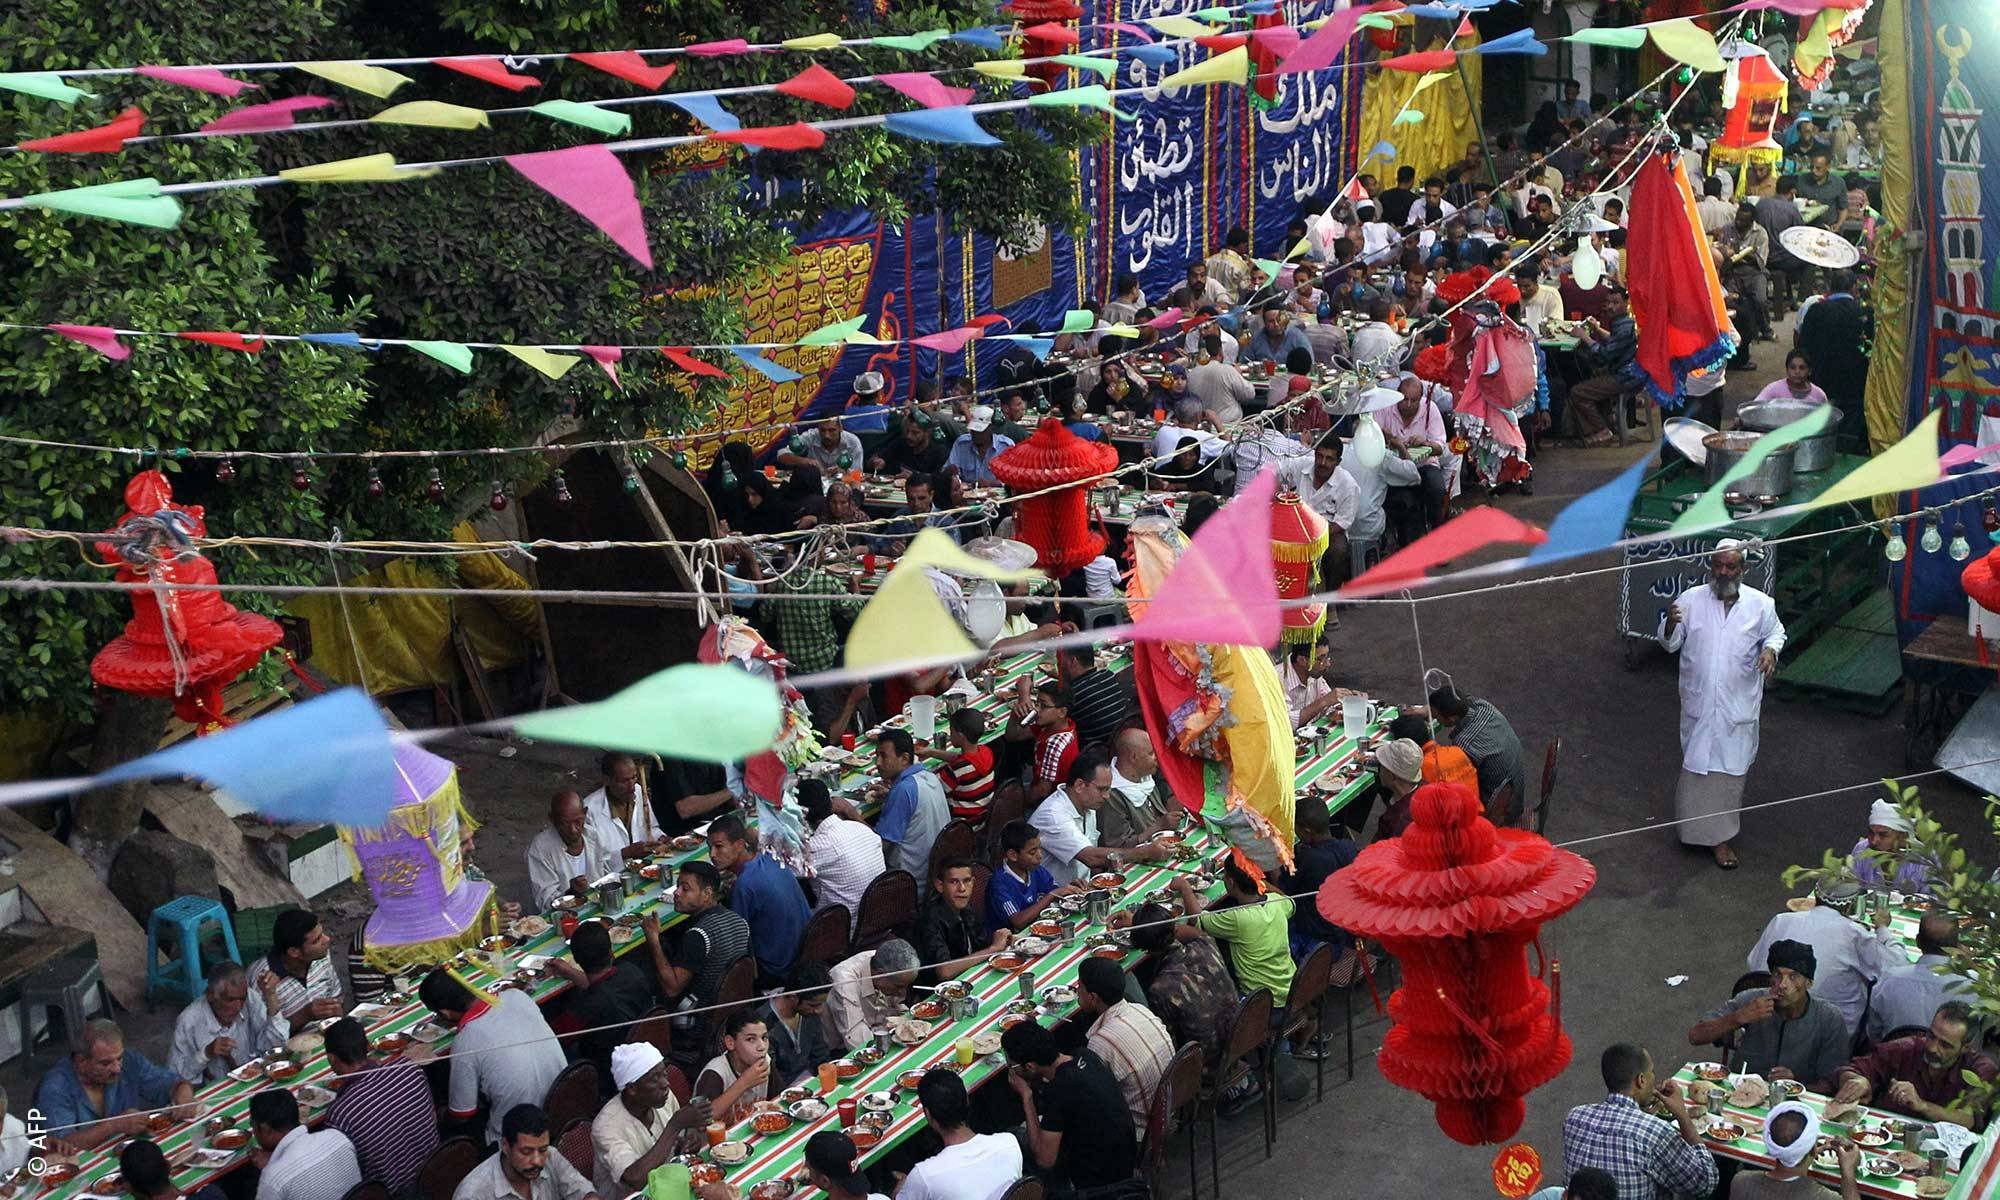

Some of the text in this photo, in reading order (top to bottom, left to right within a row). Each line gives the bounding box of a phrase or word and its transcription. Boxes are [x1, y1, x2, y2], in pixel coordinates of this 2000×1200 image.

[1260, 122, 1332, 203] الناس
[1121, 180, 1194, 273] القلوب
[1649, 573, 1682, 598] الله
